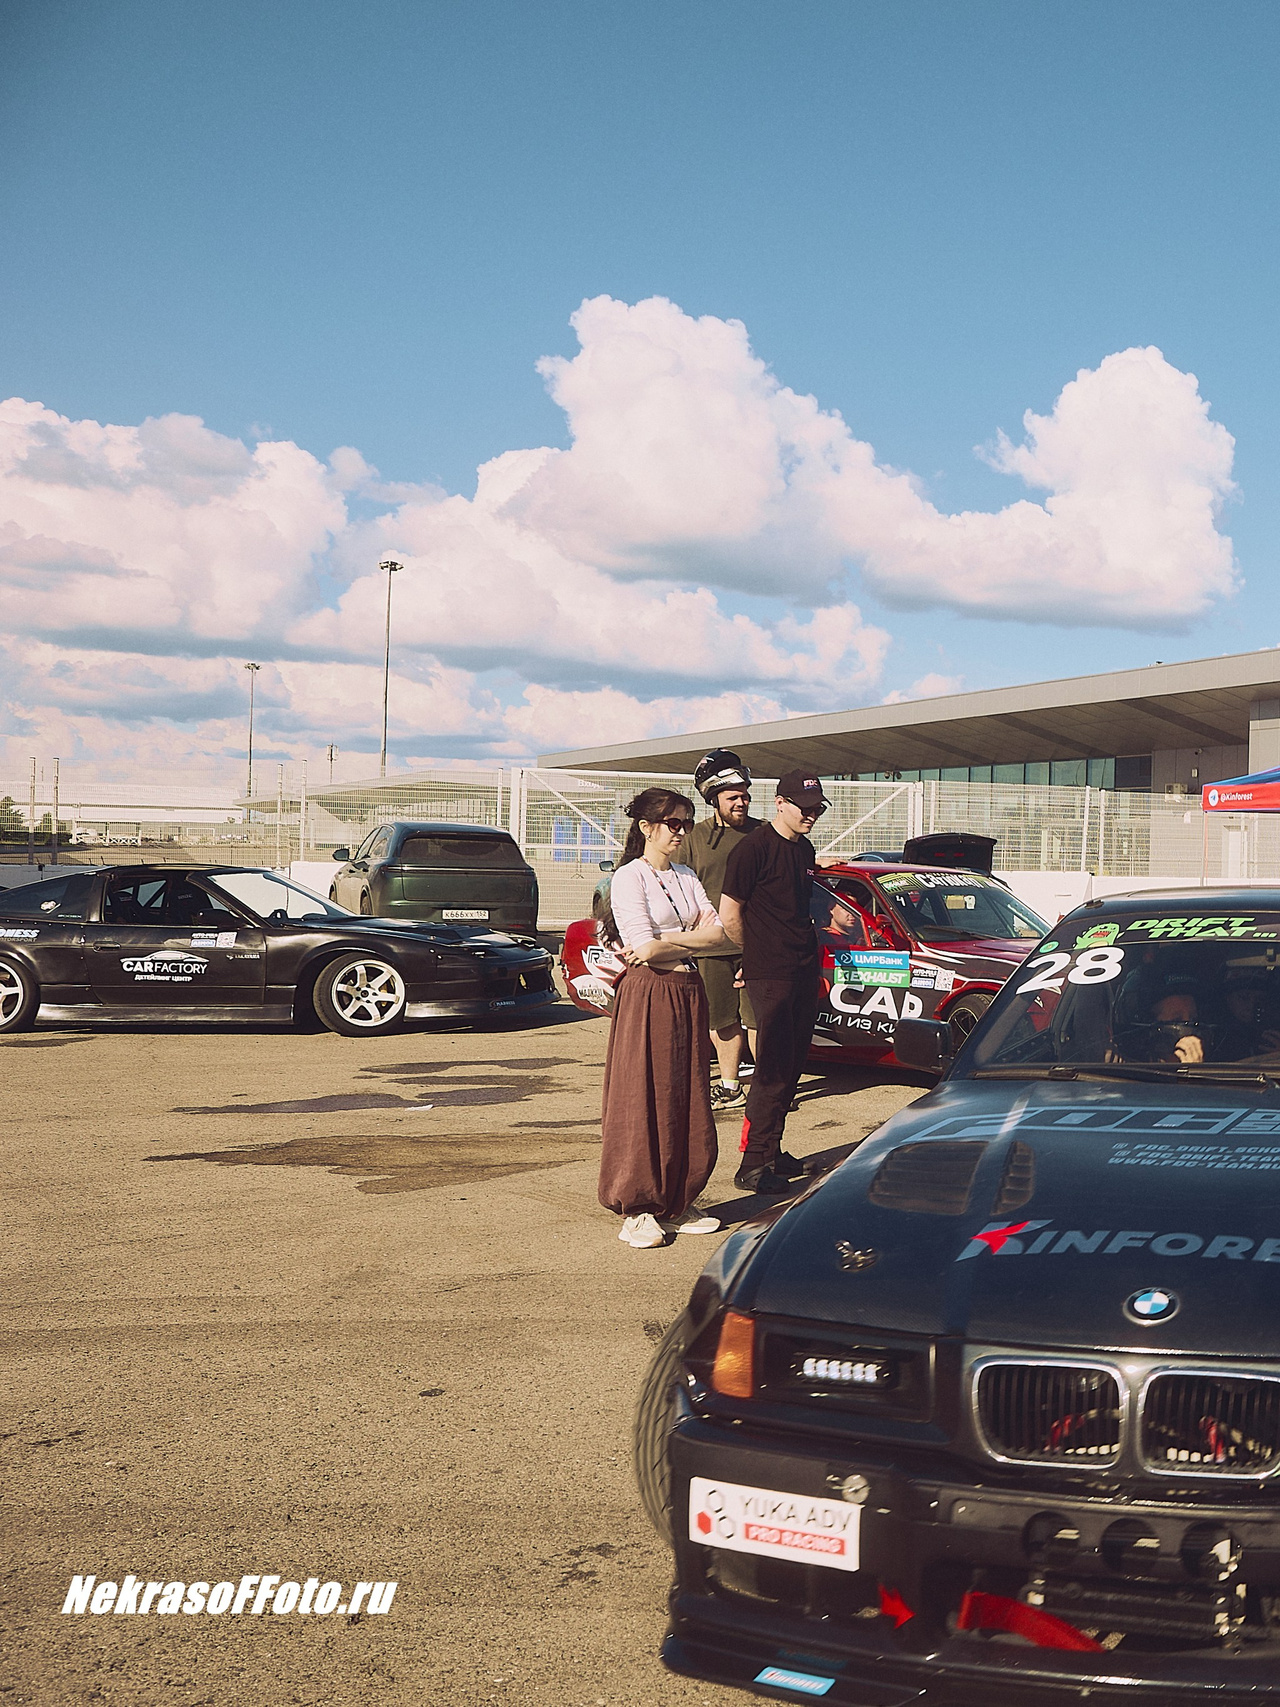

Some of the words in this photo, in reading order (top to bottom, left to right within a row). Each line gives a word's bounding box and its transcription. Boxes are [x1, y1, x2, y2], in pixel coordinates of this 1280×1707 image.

[1220, 792, 1253, 803] @Kinforest
[1126, 917, 1256, 931] DRIFT
[1148, 927, 1278, 939] THAT...
[855, 954, 903, 966] ЦМРБанк
[1016, 946, 1125, 995] 28
[850, 971, 906, 985] EXHAUST
[739, 1496, 799, 1524] YUKA
[804, 1506, 853, 1534] ADV
[748, 1526, 779, 1543] PRO
[781, 1531, 842, 1554] RACING
